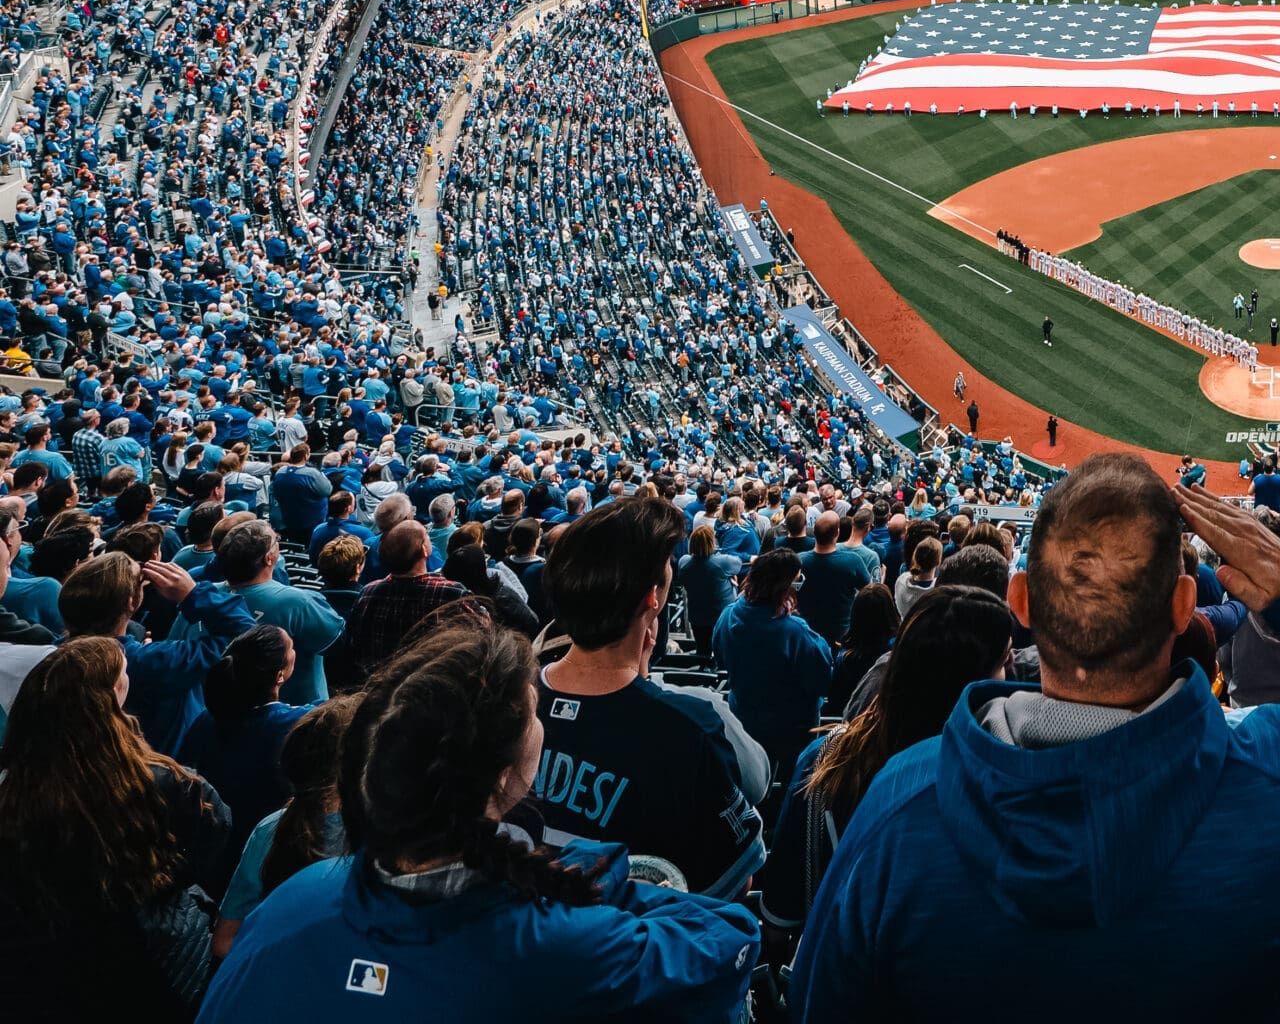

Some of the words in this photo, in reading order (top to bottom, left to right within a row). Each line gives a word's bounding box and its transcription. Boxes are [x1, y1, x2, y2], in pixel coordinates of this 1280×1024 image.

[813, 341, 848, 376] KAUFFMAN
[841, 372, 874, 403] STADIUM
[102, 451, 117, 467] 16
